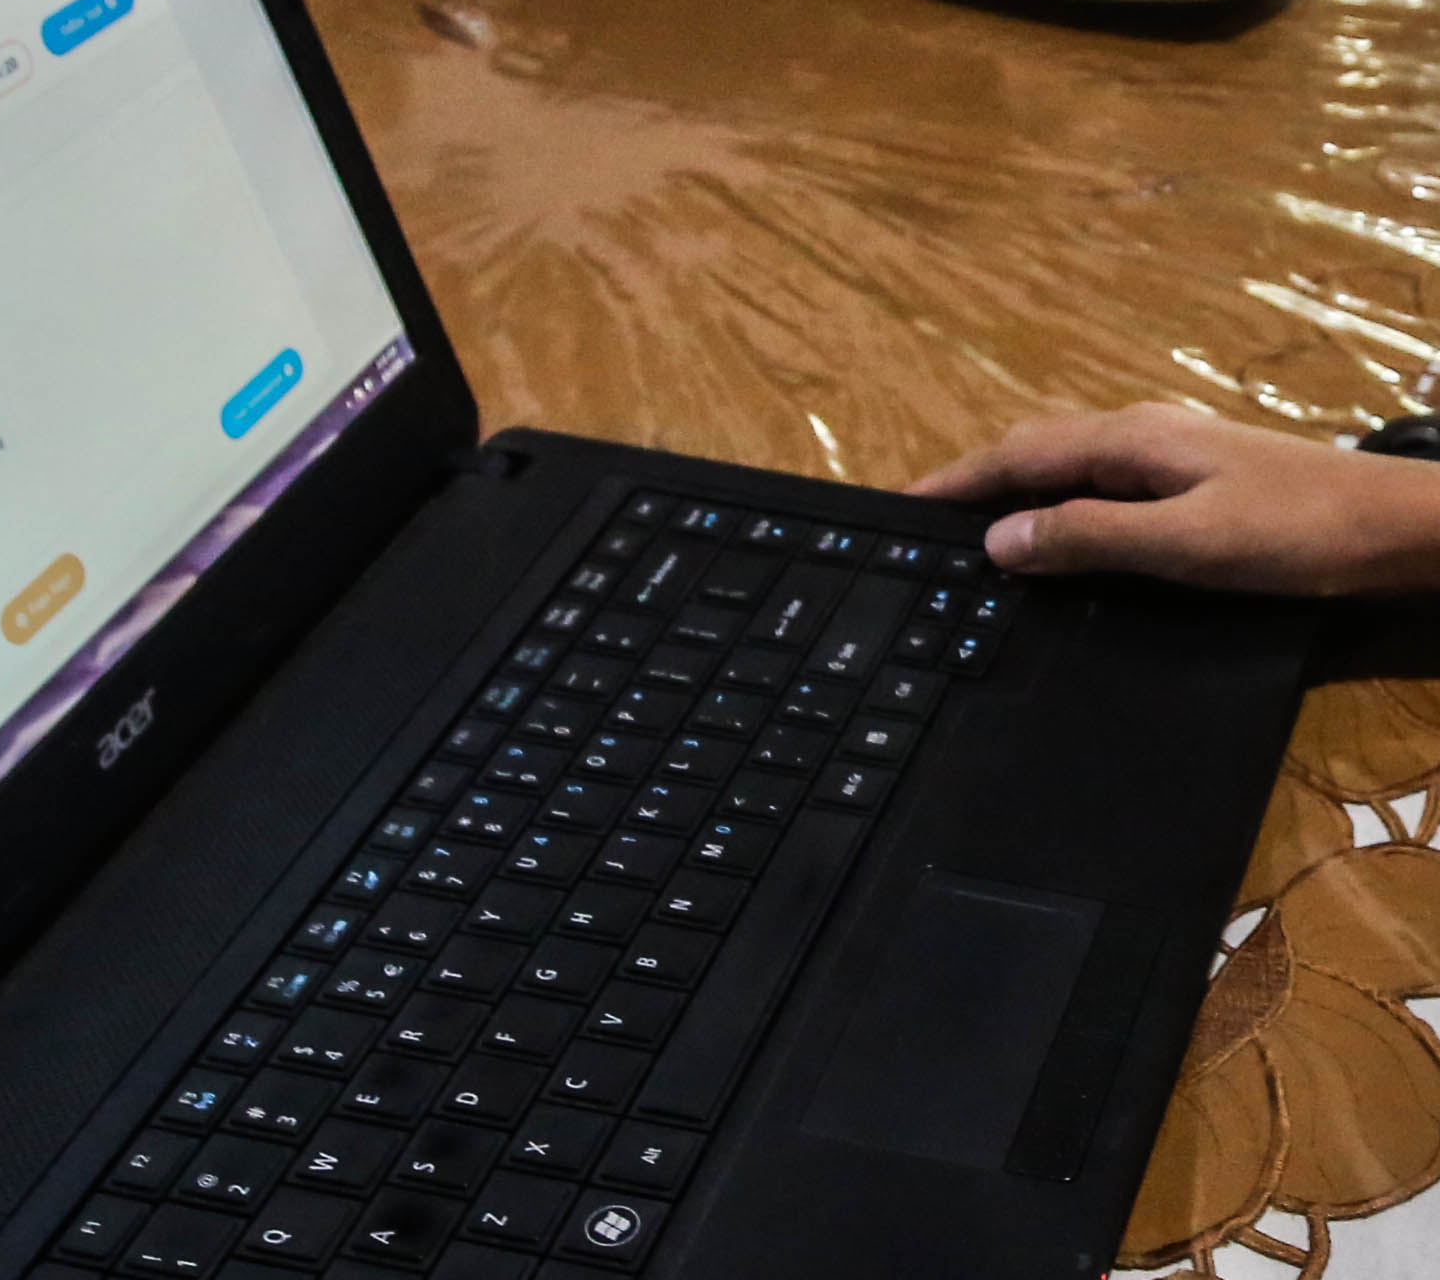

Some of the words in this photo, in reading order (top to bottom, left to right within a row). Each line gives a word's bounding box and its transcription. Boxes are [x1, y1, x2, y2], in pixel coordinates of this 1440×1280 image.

[96, 686, 156, 770] acer
[637, 806, 660, 819] K
[700, 843, 725, 858] M
[515, 857, 539, 868] U
[668, 898, 694, 911] N
[479, 909, 502, 921] Y
[570, 911, 595, 925] H
[635, 957, 659, 969] B
[439, 968, 464, 979] T
[535, 968, 558, 981] G
[365, 989, 385, 1000] 5
[599, 1013, 624, 1025] V
[399, 1029, 425, 1043] R
[494, 1032, 517, 1044] F
[324, 1049, 344, 1061] 4
[564, 1076, 589, 1090] C
[355, 1093, 381, 1105] E
[455, 1091, 479, 1106] D
[276, 1115, 298, 1127] 3
[524, 1141, 551, 1156] X
[130, 1154, 151, 1167] F2
[309, 1151, 340, 1172] W
[640, 1147, 663, 1165] Alt
[412, 1160, 436, 1174] S
[196, 1173, 219, 1189] @
[227, 1184, 251, 1196] 2
[481, 1211, 509, 1227] Z
[80, 1221, 101, 1234] F1
[262, 1228, 293, 1244] Q
[369, 1228, 397, 1246] A
